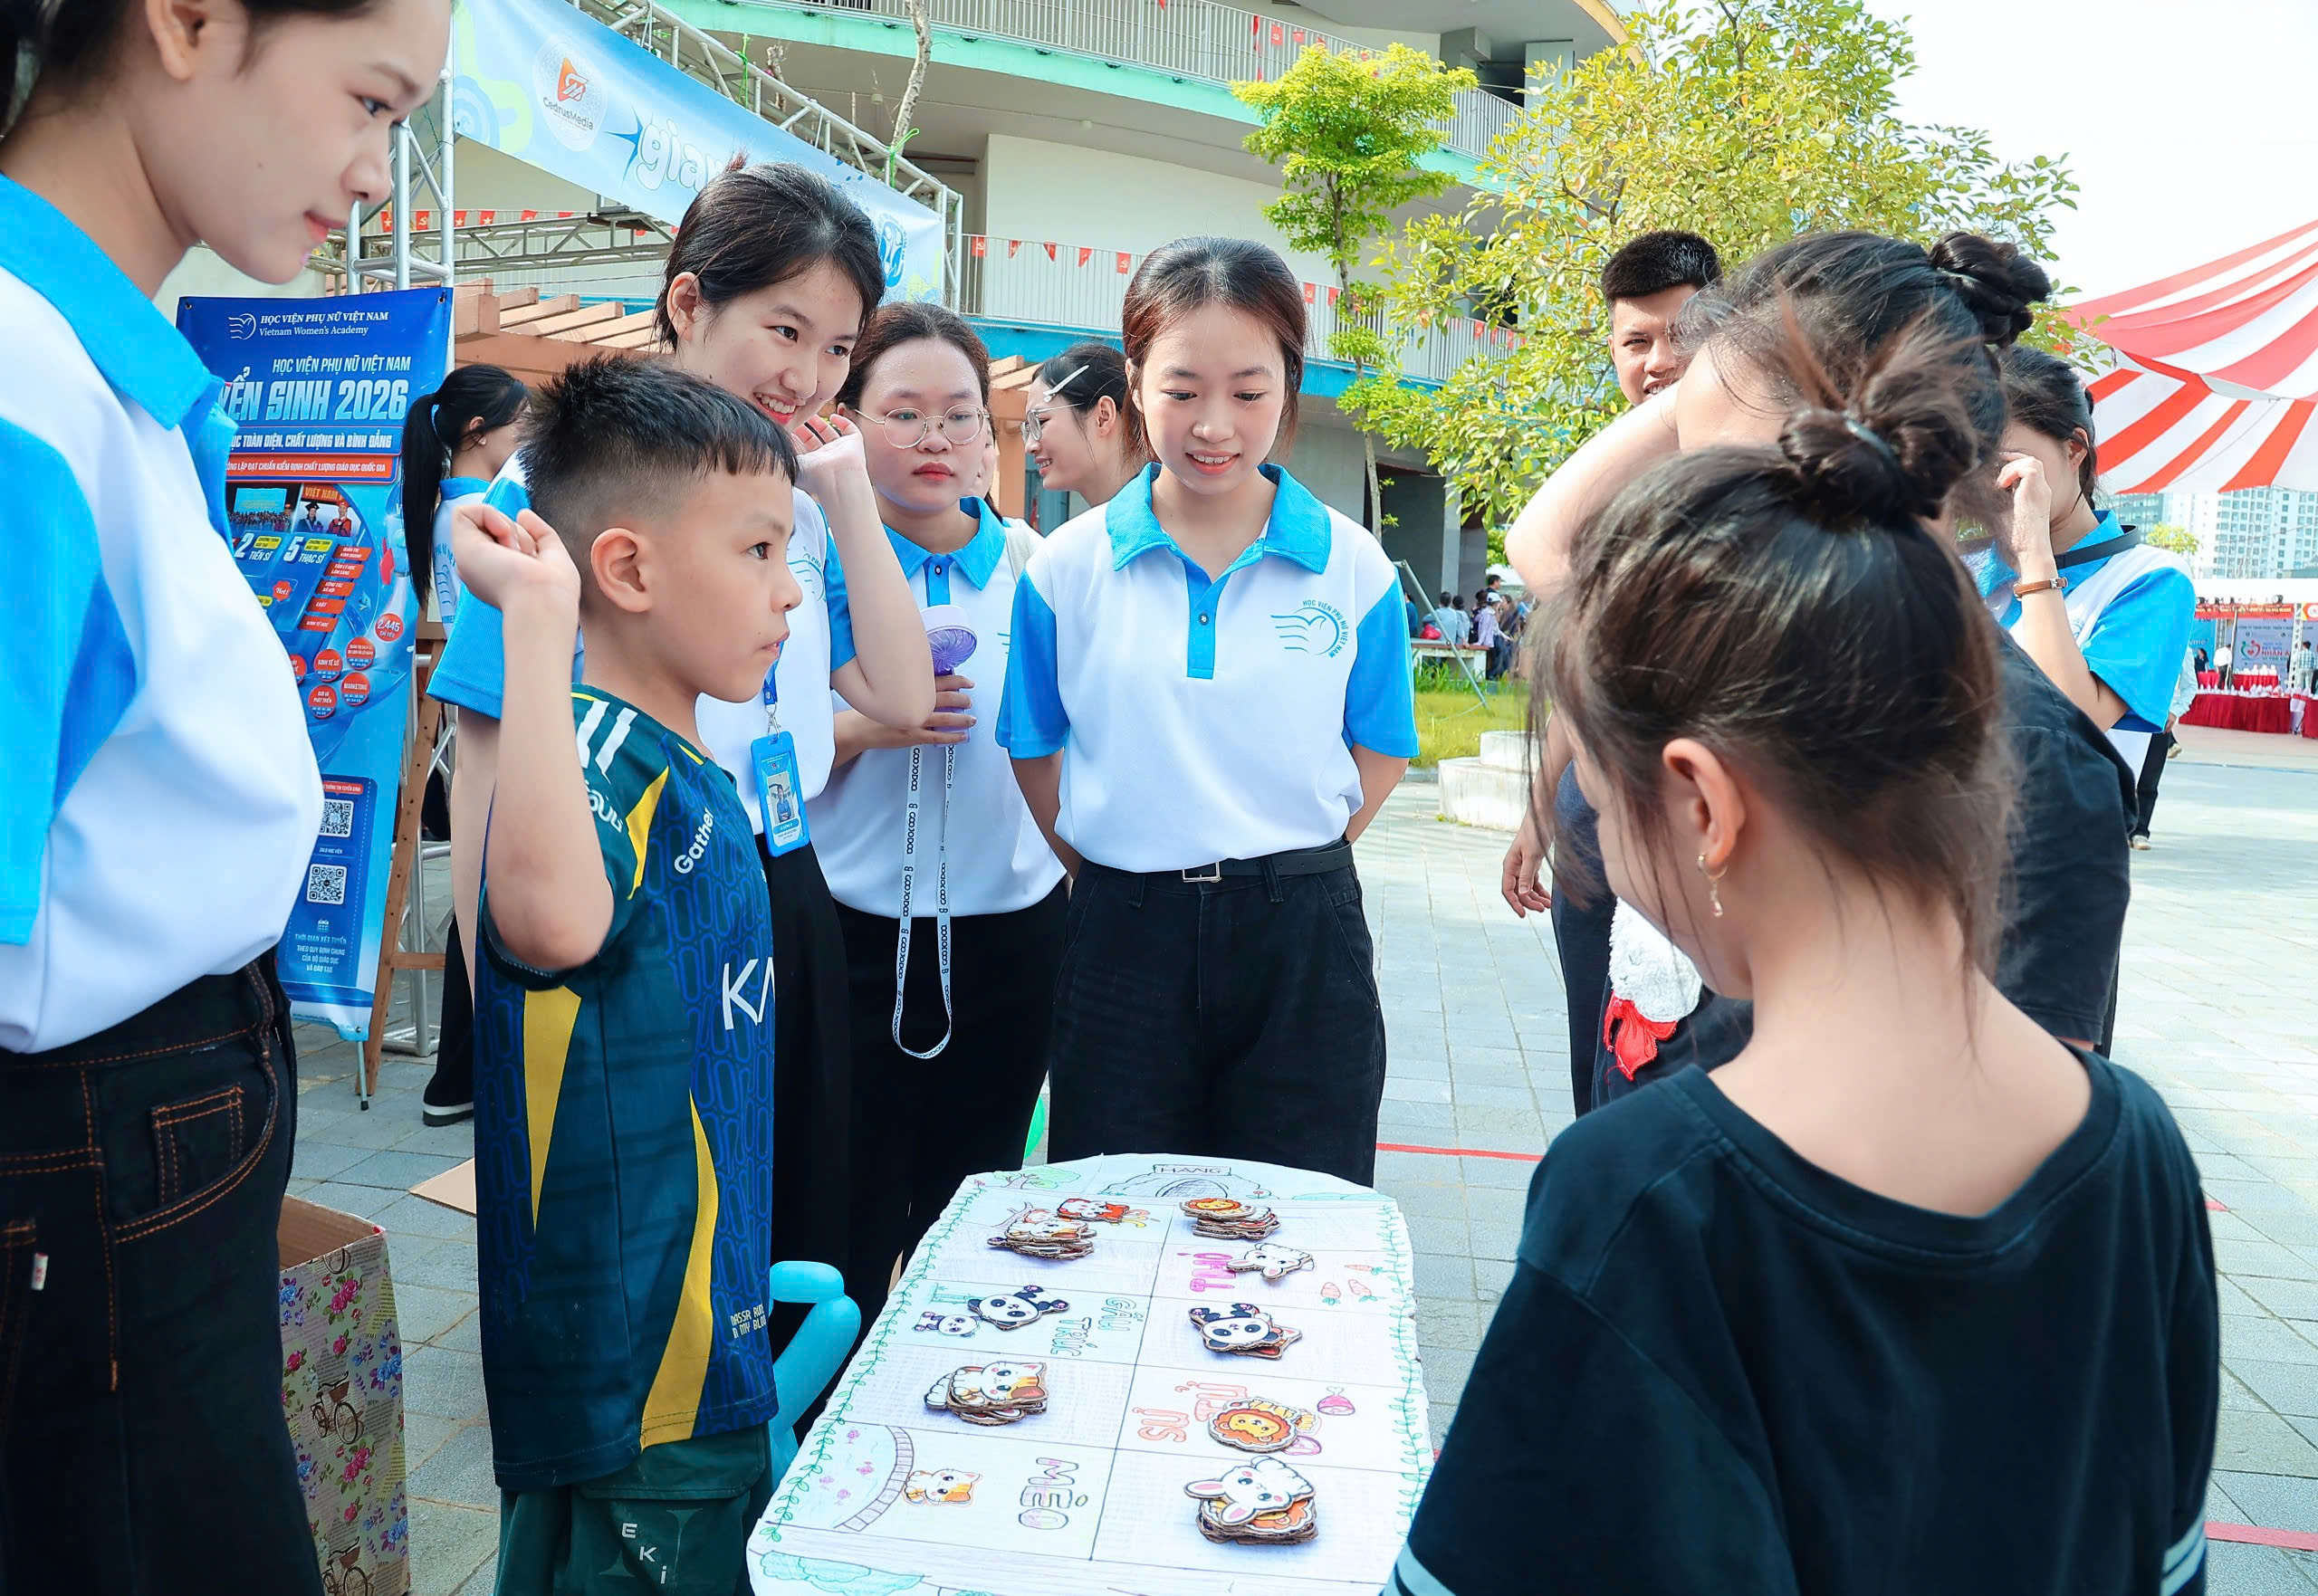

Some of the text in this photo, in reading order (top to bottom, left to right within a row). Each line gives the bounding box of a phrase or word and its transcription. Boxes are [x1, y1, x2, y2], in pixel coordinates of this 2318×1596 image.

[542, 96, 594, 130] CedrusMedia
[260, 311, 388, 326] HỌC VIỆN PHỤ NỮ VIỆT NAM
[259, 325, 369, 337] Vietnam Women's Academy
[273, 354, 411, 376] HỌC VIỆN PHỤ NỮ VIỆT NAM
[217, 367, 409, 421] YỂN SINH 2026
[232, 429, 392, 451] ỤC TOÀN DIỆN, CHẤT LƯỢNG VÀ BÌNH ĐẲNG
[225, 462, 237, 471] ÔNG
[376, 464, 386, 472] GIA
[234, 532, 254, 559] 2
[248, 550, 273, 561] TIẾN SĨ
[283, 536, 304, 562] 5
[298, 553, 327, 564] THẠC SĨ
[1302, 599, 1317, 607] HỌC
[1317, 601, 1333, 612] VIỆN
[1332, 608, 1344, 621] PHỤ
[377, 620, 400, 633] 2.445
